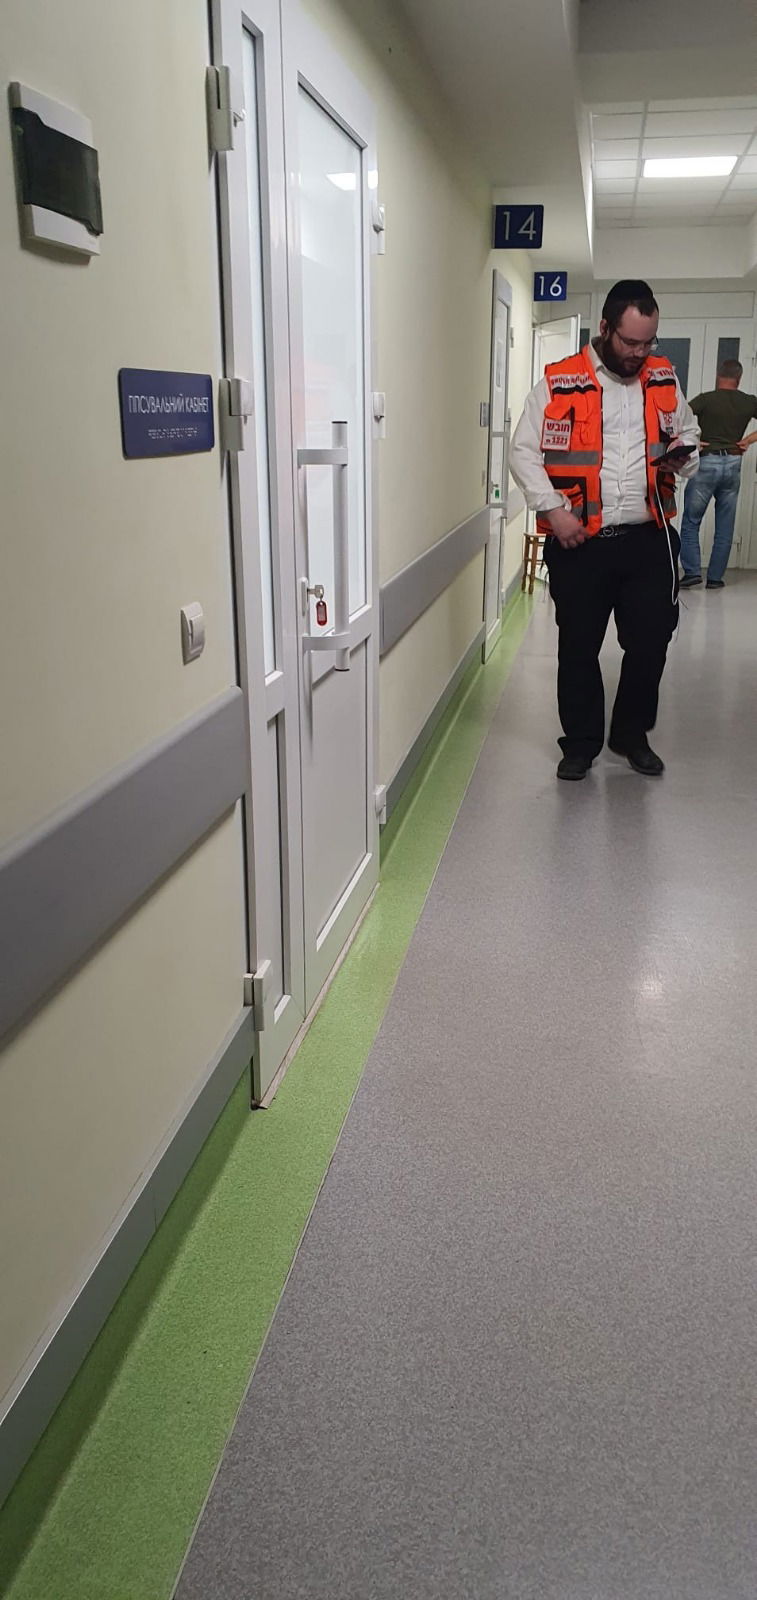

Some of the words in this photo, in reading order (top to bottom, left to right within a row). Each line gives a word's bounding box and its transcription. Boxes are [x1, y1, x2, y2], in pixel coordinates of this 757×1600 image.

[503, 211, 537, 241] 14
[539, 276, 562, 297] 16
[185, 396, 209, 413] КАБІНЕТ
[546, 422, 570, 432] חובש
